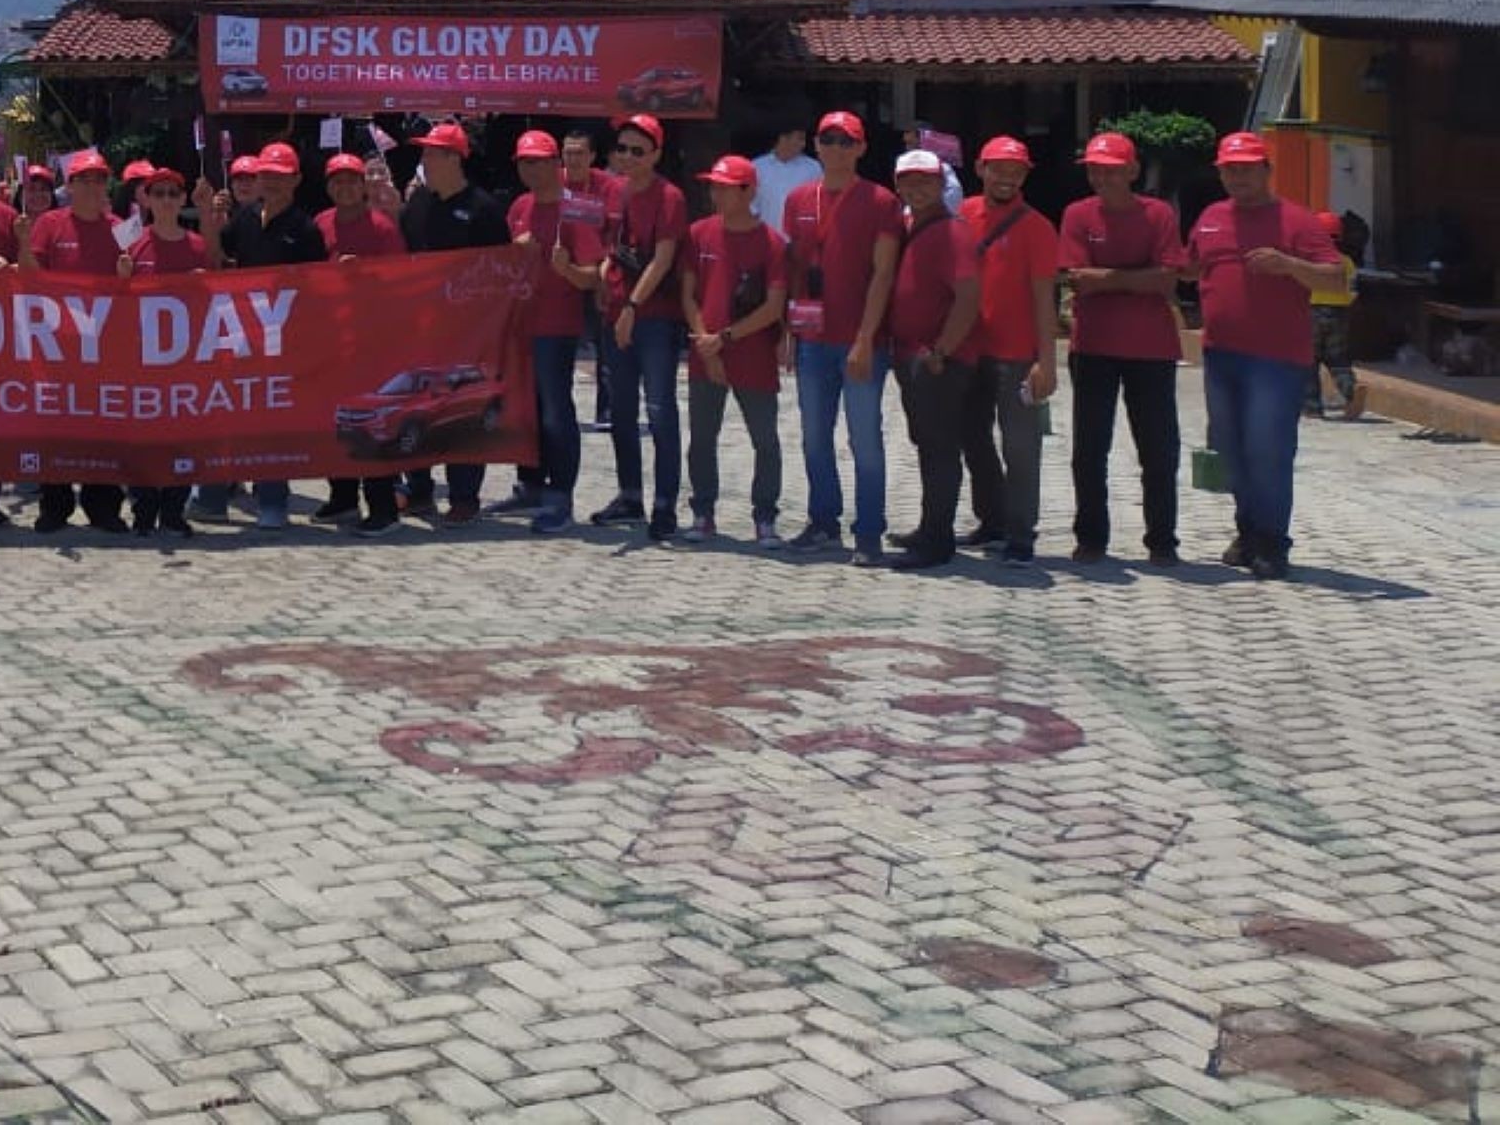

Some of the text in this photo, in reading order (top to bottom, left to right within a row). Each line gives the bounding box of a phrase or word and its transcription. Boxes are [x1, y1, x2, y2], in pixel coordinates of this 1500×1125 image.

[284, 26, 600, 56] DFSK GLORY DAY
[282, 63, 600, 82] TOGETHER WE CELEBRATE
[138, 289, 298, 367] DAY
